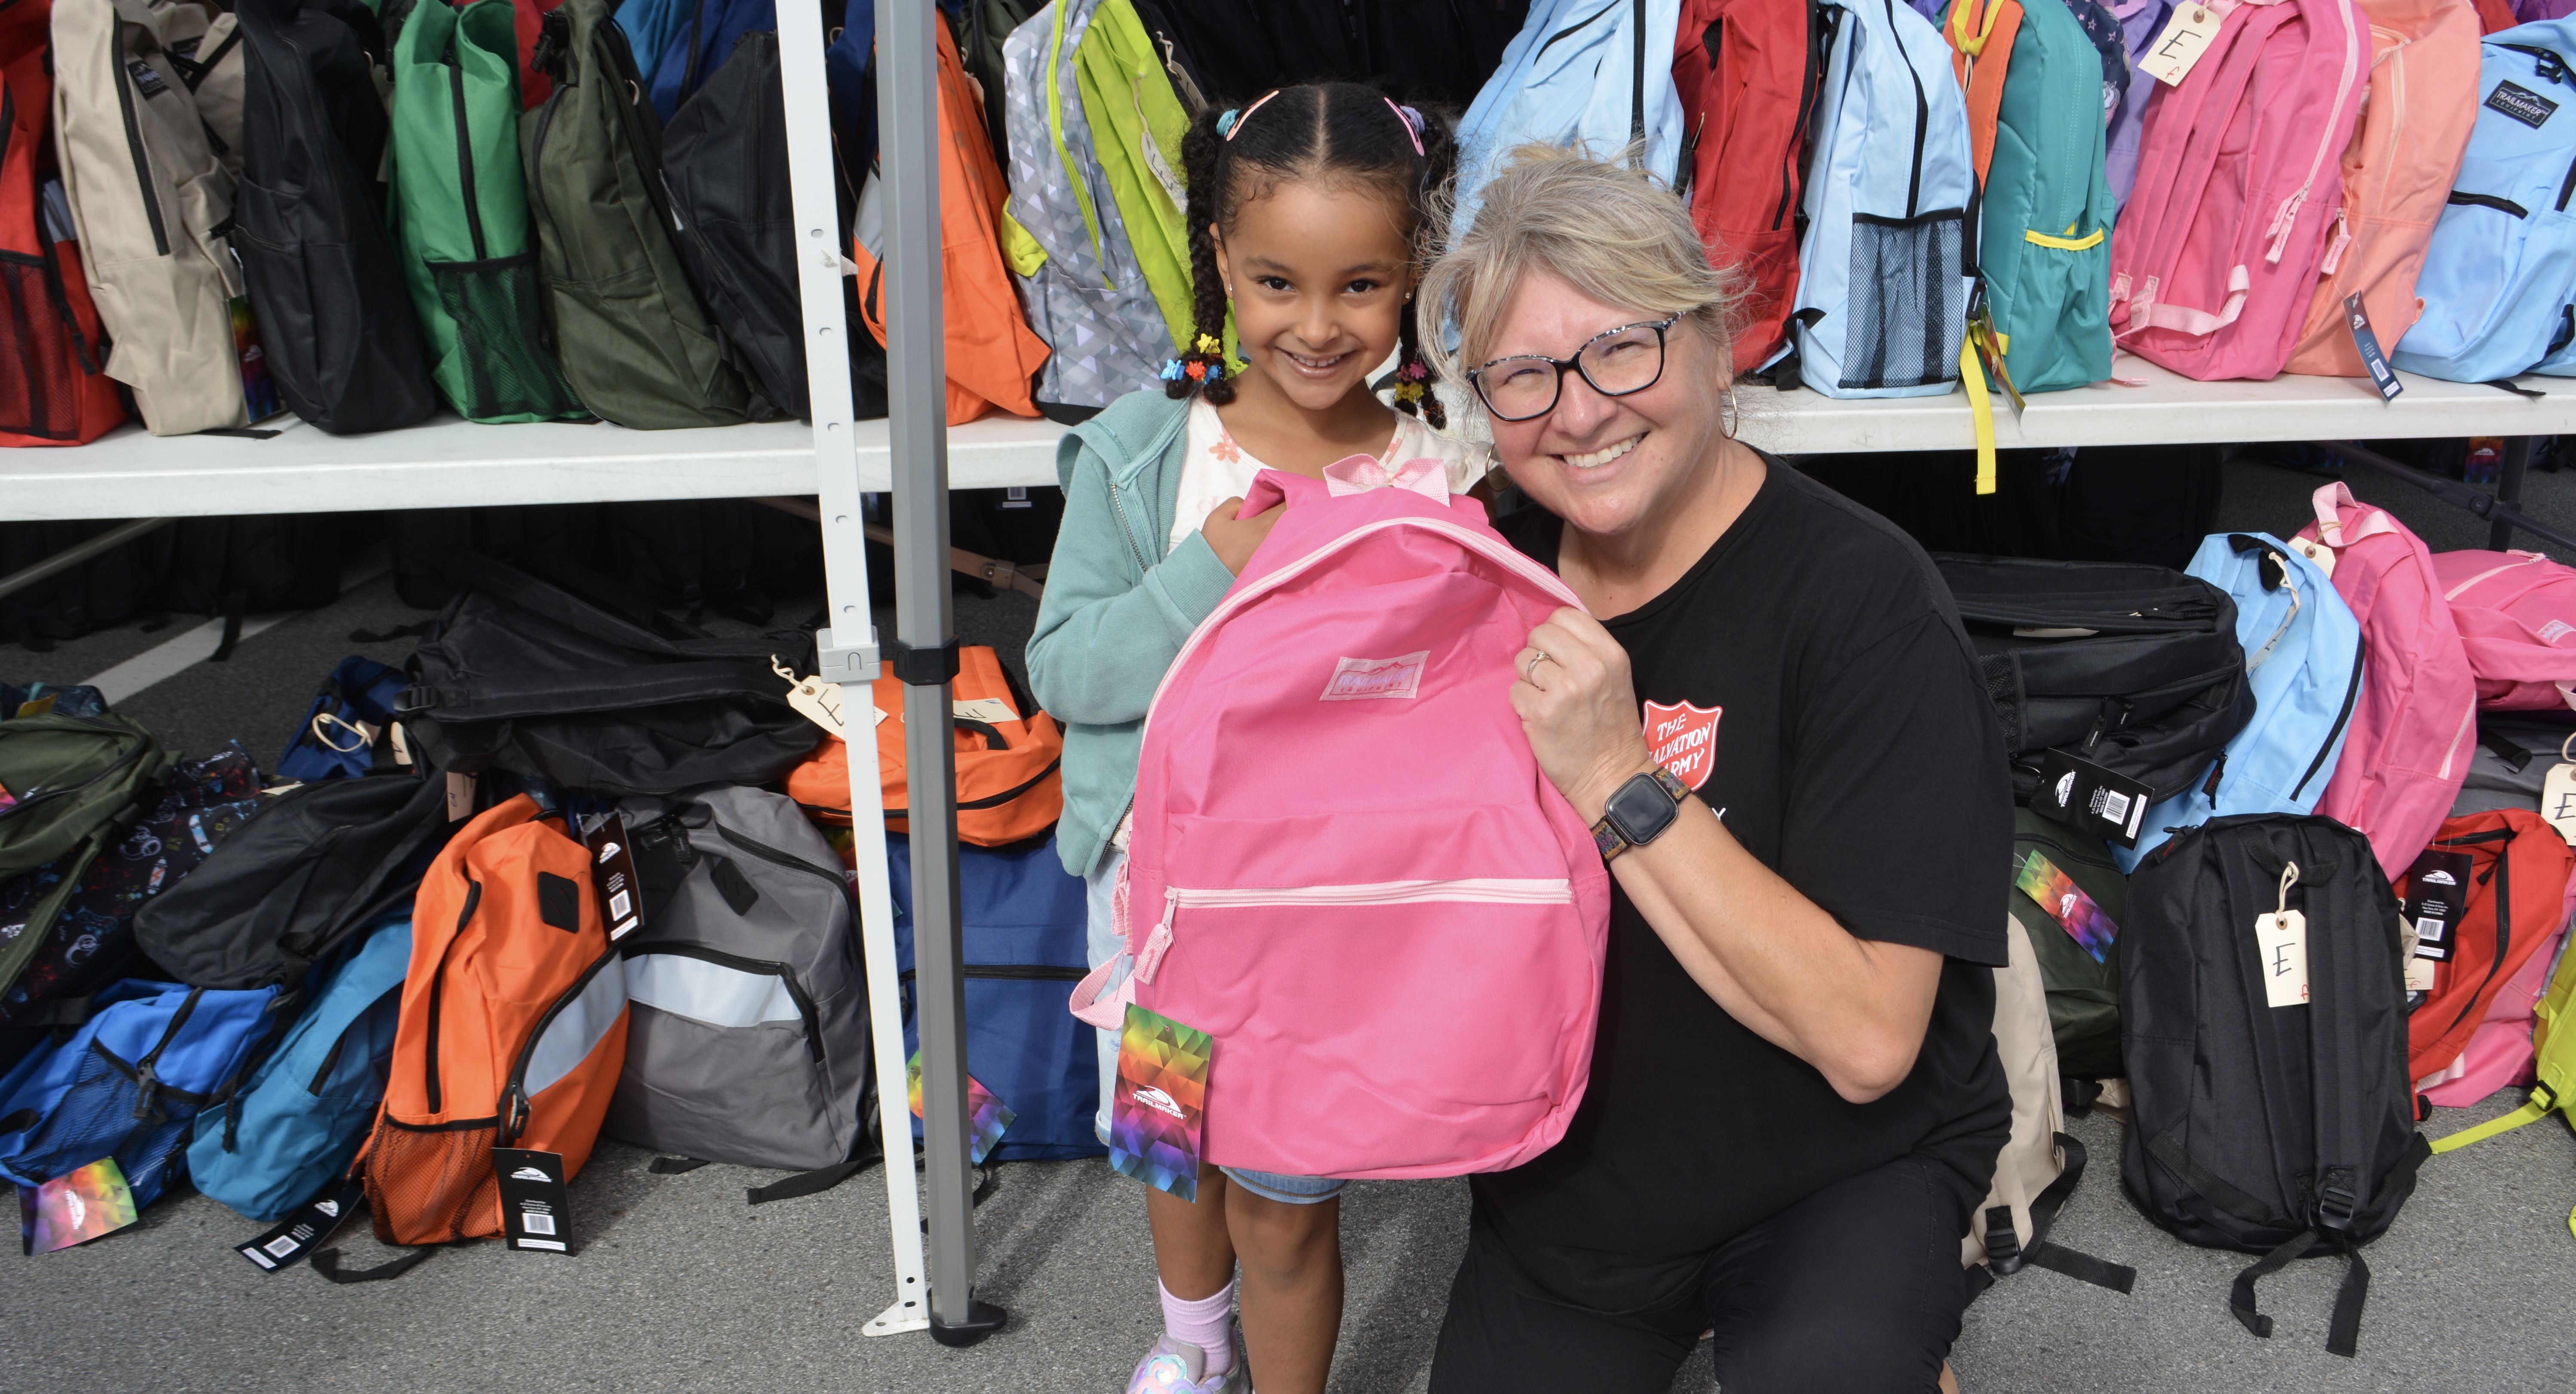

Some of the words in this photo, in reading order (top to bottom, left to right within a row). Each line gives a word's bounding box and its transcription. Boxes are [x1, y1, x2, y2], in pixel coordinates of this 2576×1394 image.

[2159, 30, 2201, 59] E
[2496, 99, 2536, 120] EQUIPMENT
[1657, 713, 1686, 742] THE
[1648, 722, 1711, 764] ALVATION
[2554, 792, 2576, 820] E
[2272, 942, 2296, 977] E
